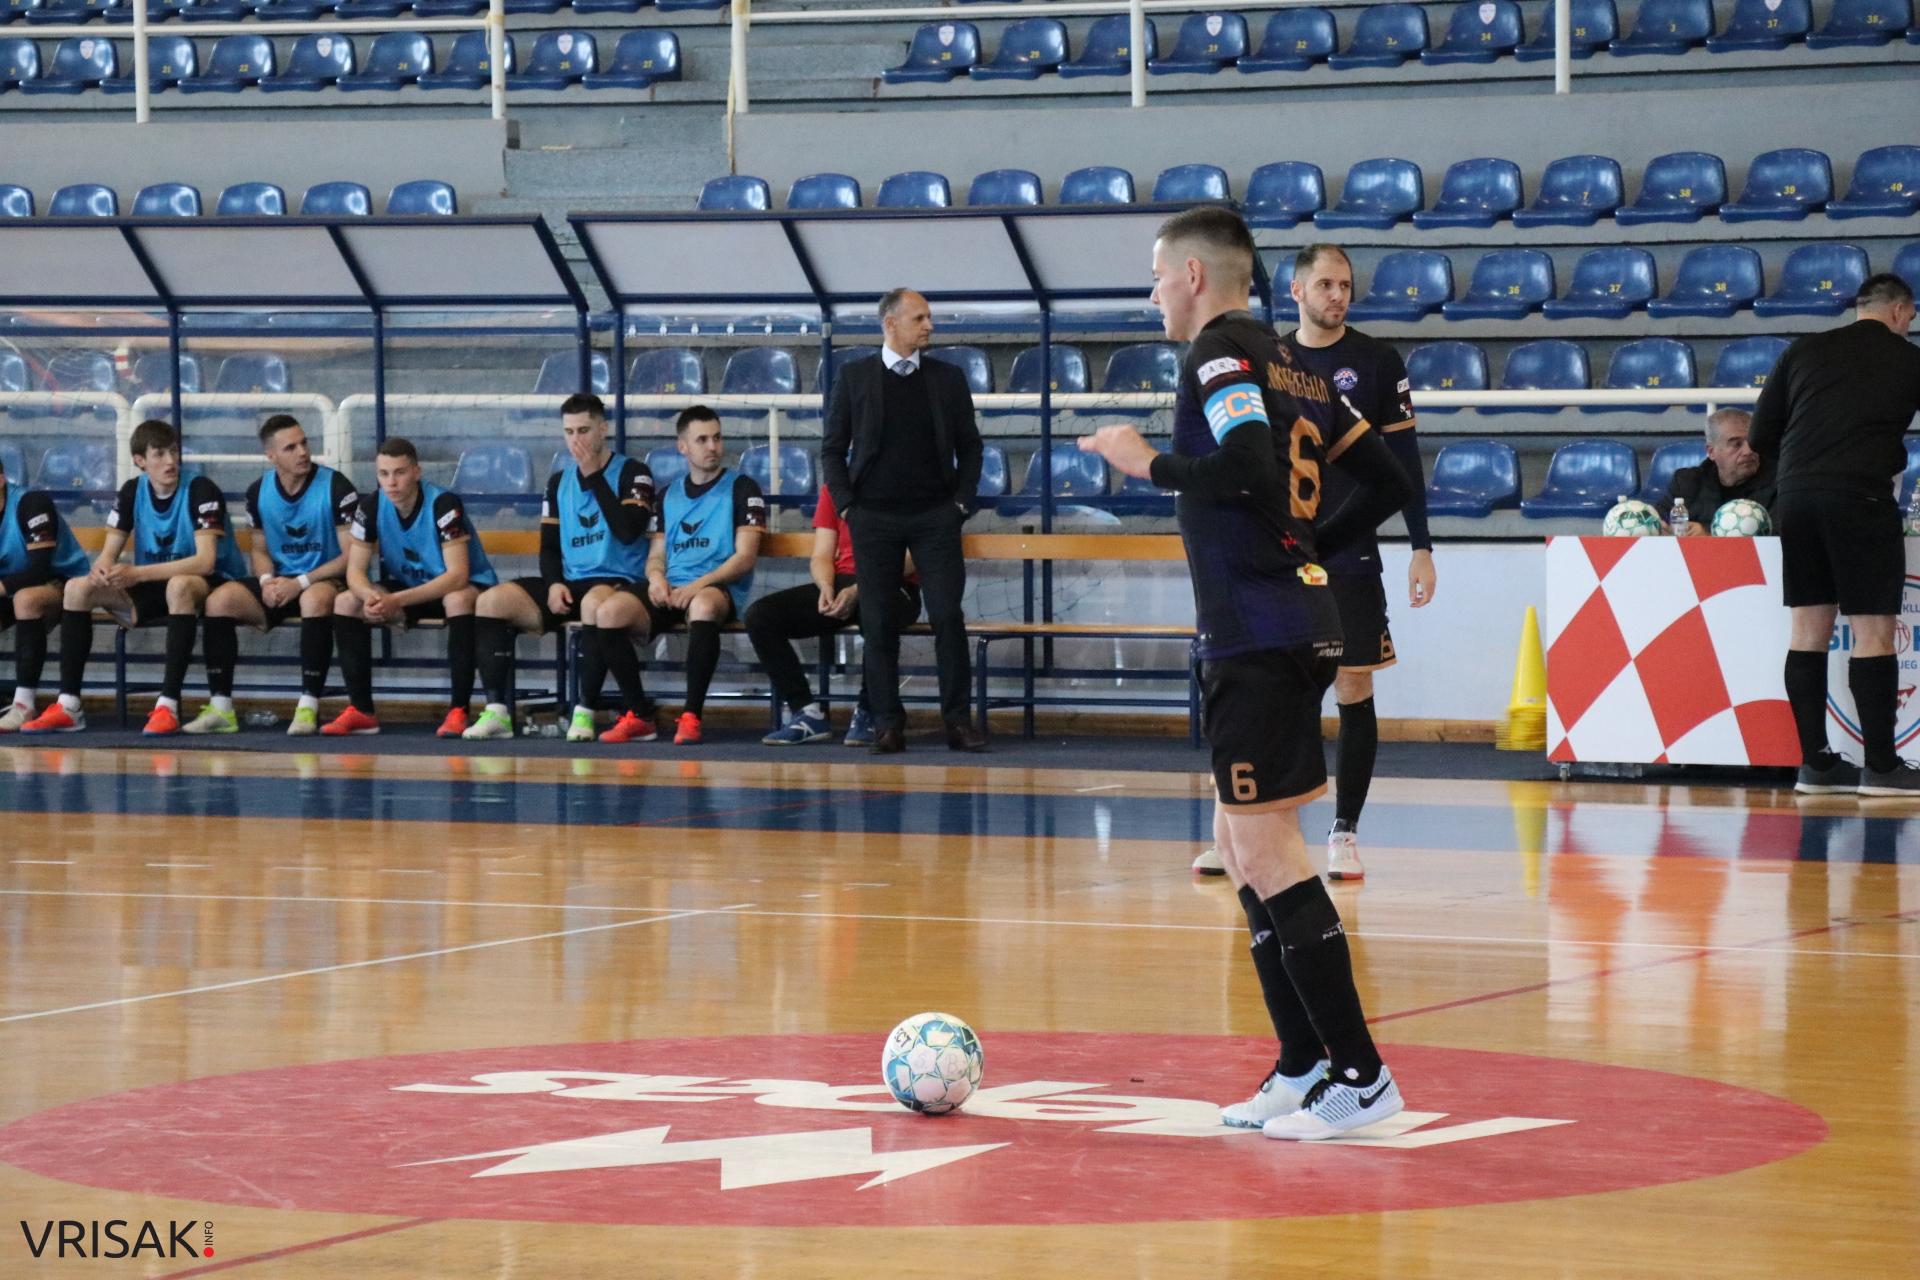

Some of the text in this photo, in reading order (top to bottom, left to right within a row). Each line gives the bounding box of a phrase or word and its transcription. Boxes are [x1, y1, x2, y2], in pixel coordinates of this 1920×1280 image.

[1609, 282, 1622, 293] 37
[1647, 376, 1661, 387] 36
[1754, 374, 1767, 386] 37
[1225, 391, 1252, 418] C
[1289, 416, 1324, 521] 6
[1230, 762, 1258, 802] 6
